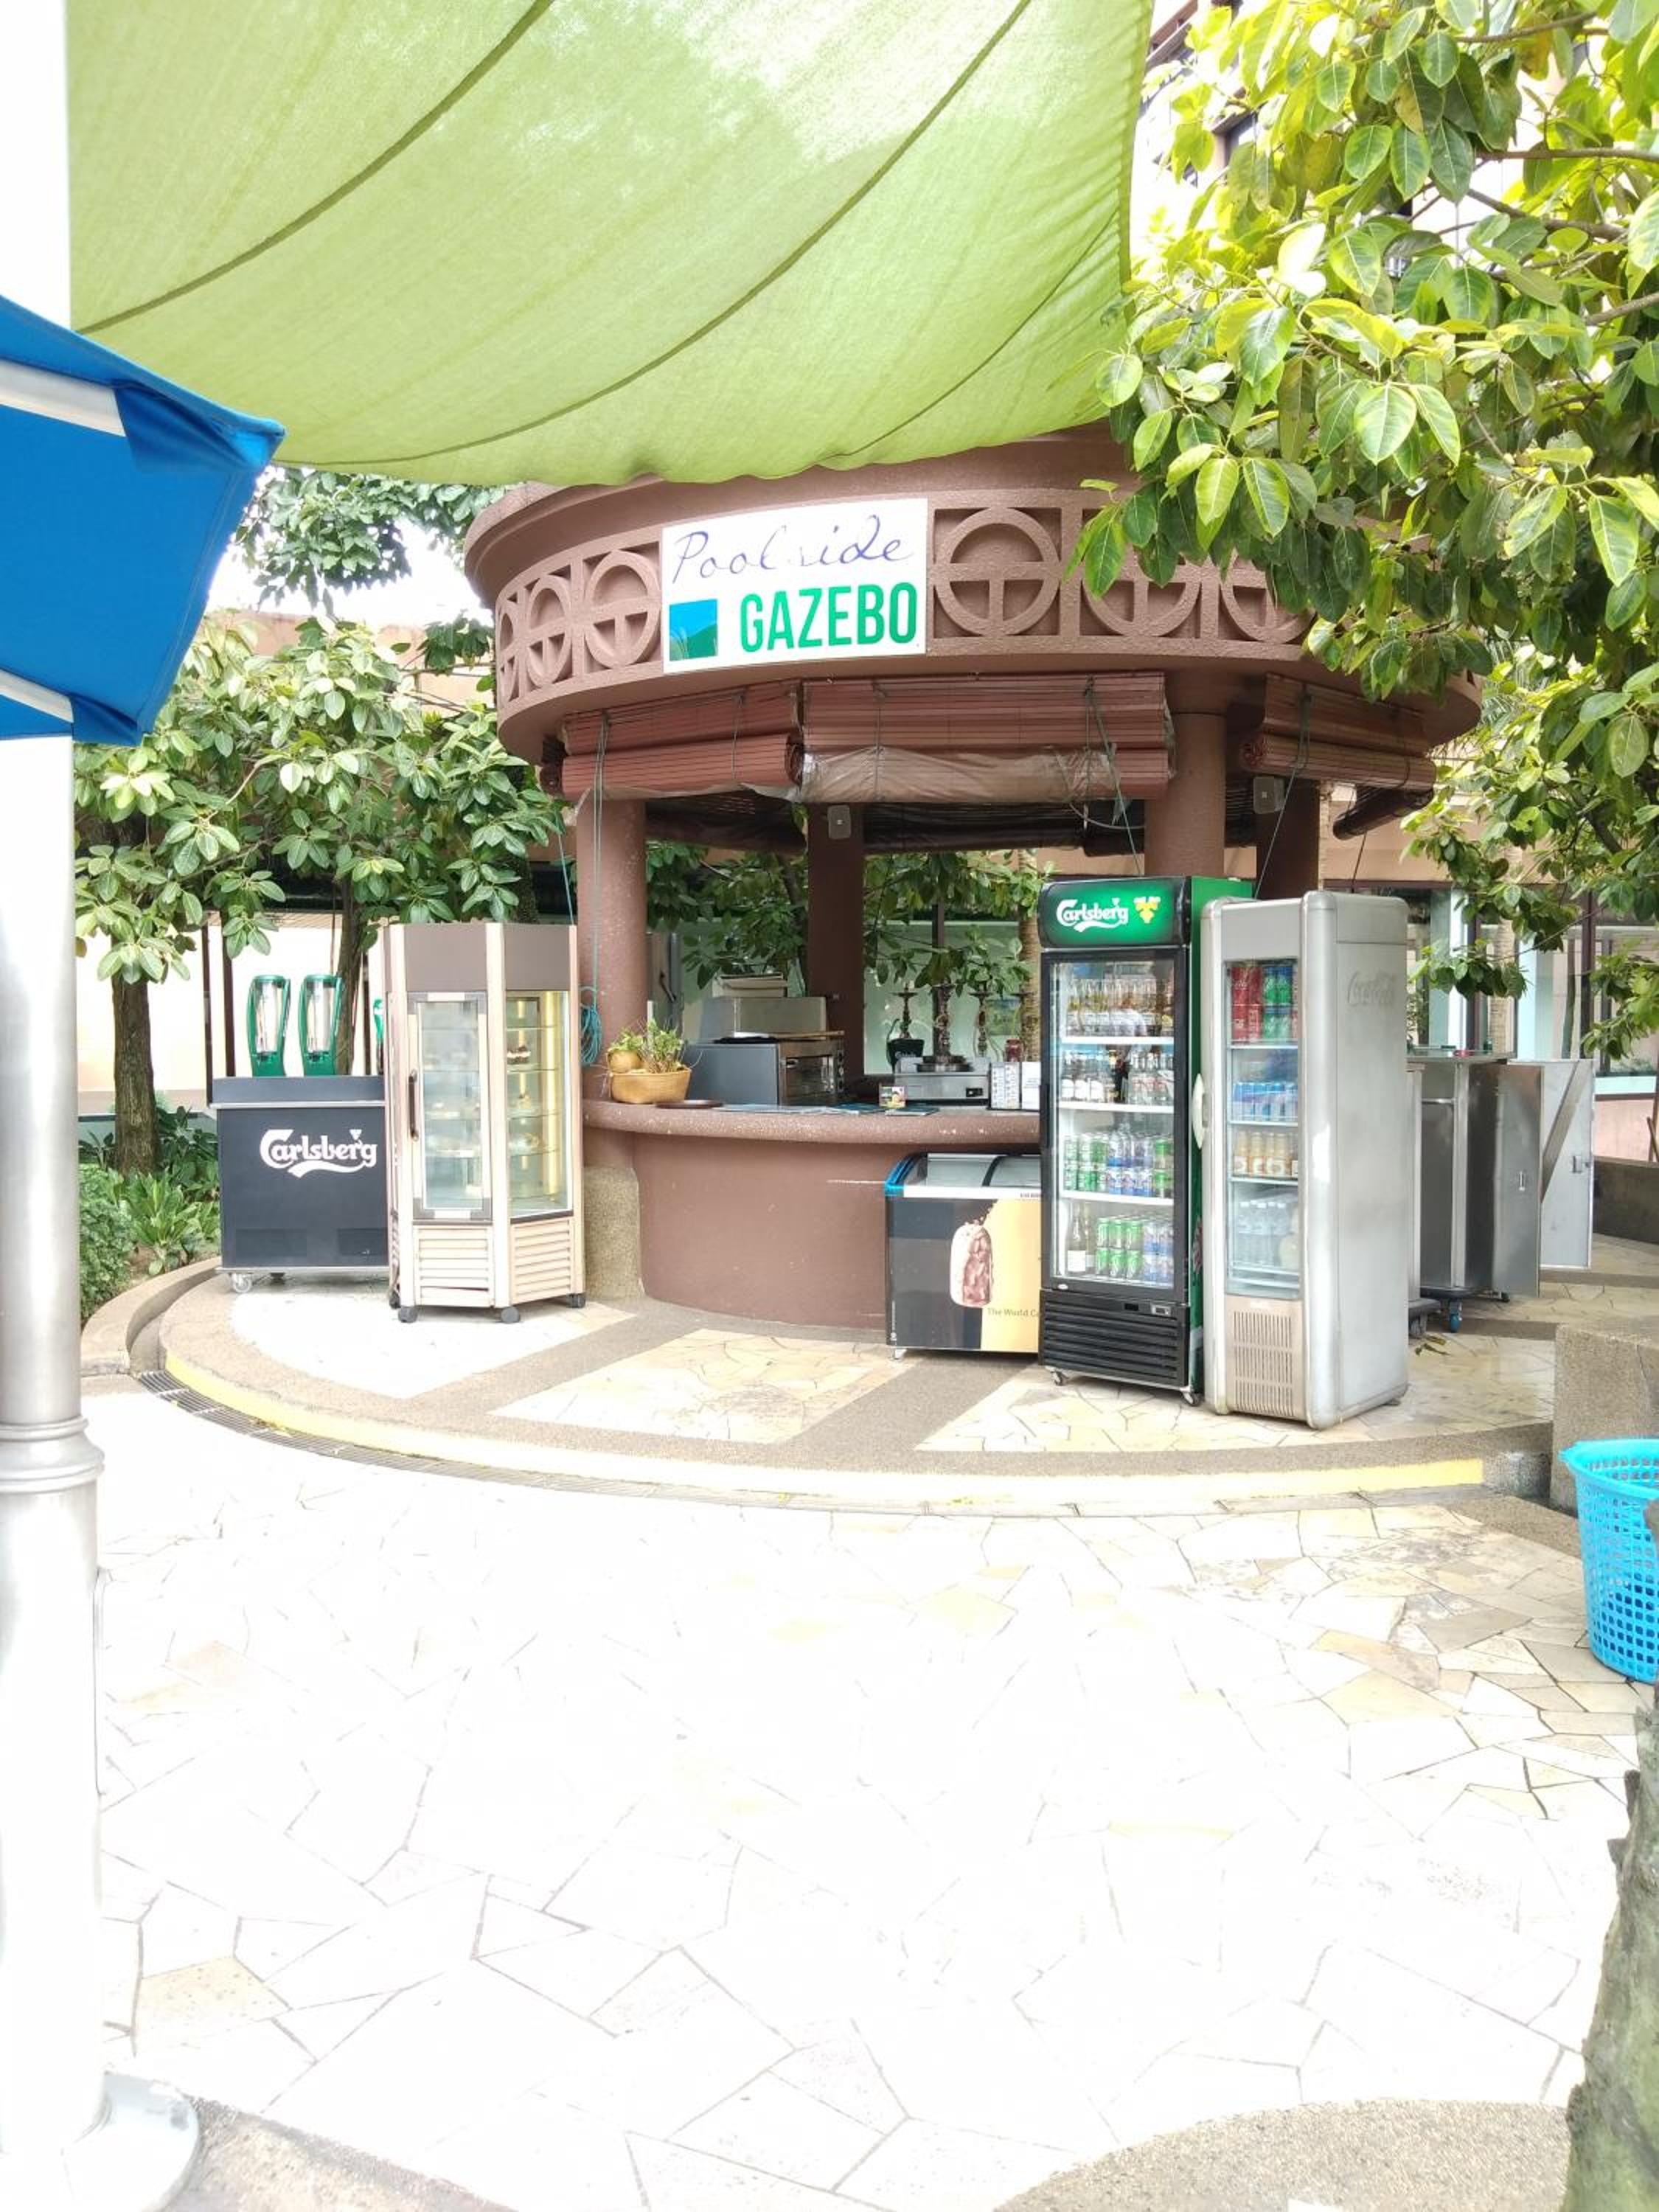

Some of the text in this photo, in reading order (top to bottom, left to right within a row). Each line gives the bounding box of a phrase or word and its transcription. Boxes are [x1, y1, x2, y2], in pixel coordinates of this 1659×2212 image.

[672, 514, 913, 585] Poolide
[740, 582, 918, 653] GAZEBO
[1056, 897, 1129, 929] Carlsberg
[260, 1129, 378, 1172] Carlsberg
